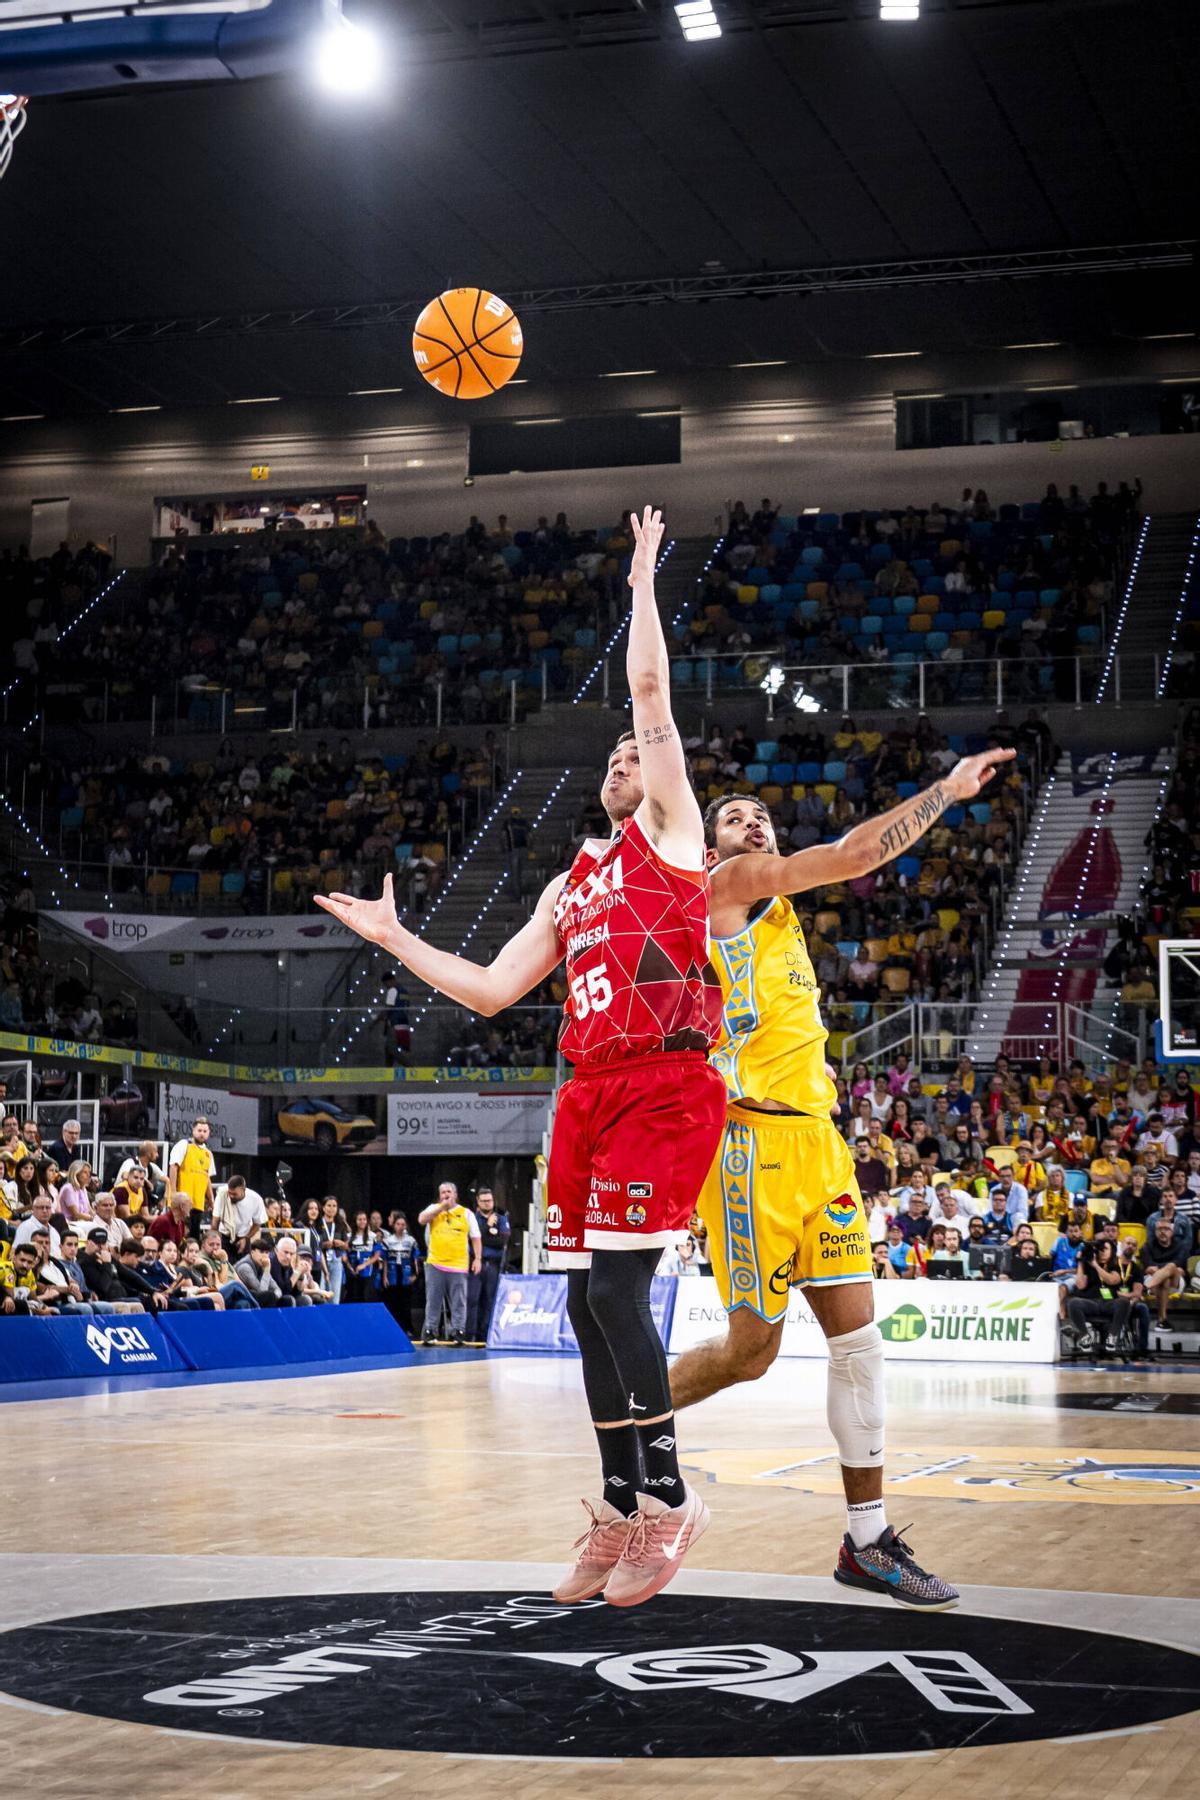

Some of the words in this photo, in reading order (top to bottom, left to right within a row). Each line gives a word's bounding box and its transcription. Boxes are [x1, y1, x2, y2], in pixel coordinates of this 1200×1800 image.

[880, 817, 910, 860] SELF
[111, 919, 148, 941] trop
[231, 926, 275, 940] trop
[565, 921, 611, 958] ANRESA
[571, 962, 613, 1021] 55
[396, 1101, 433, 1111] TOYOTA
[435, 1101, 463, 1110] AYGO
[464, 1100, 472, 1110] X
[474, 1100, 506, 1110] CROSS
[508, 1099, 545, 1110] HYBRID
[630, 1188, 646, 1196] acb
[819, 1231, 865, 1245] Poema
[821, 1246, 842, 1259] del
[846, 1243, 866, 1256] Mar
[931, 1304, 980, 1316] GRUPO
[930, 1315, 1034, 1342] JUCARNE
[104, 1326, 150, 1351] CRI
[121, 1352, 158, 1363] CANARIAS
